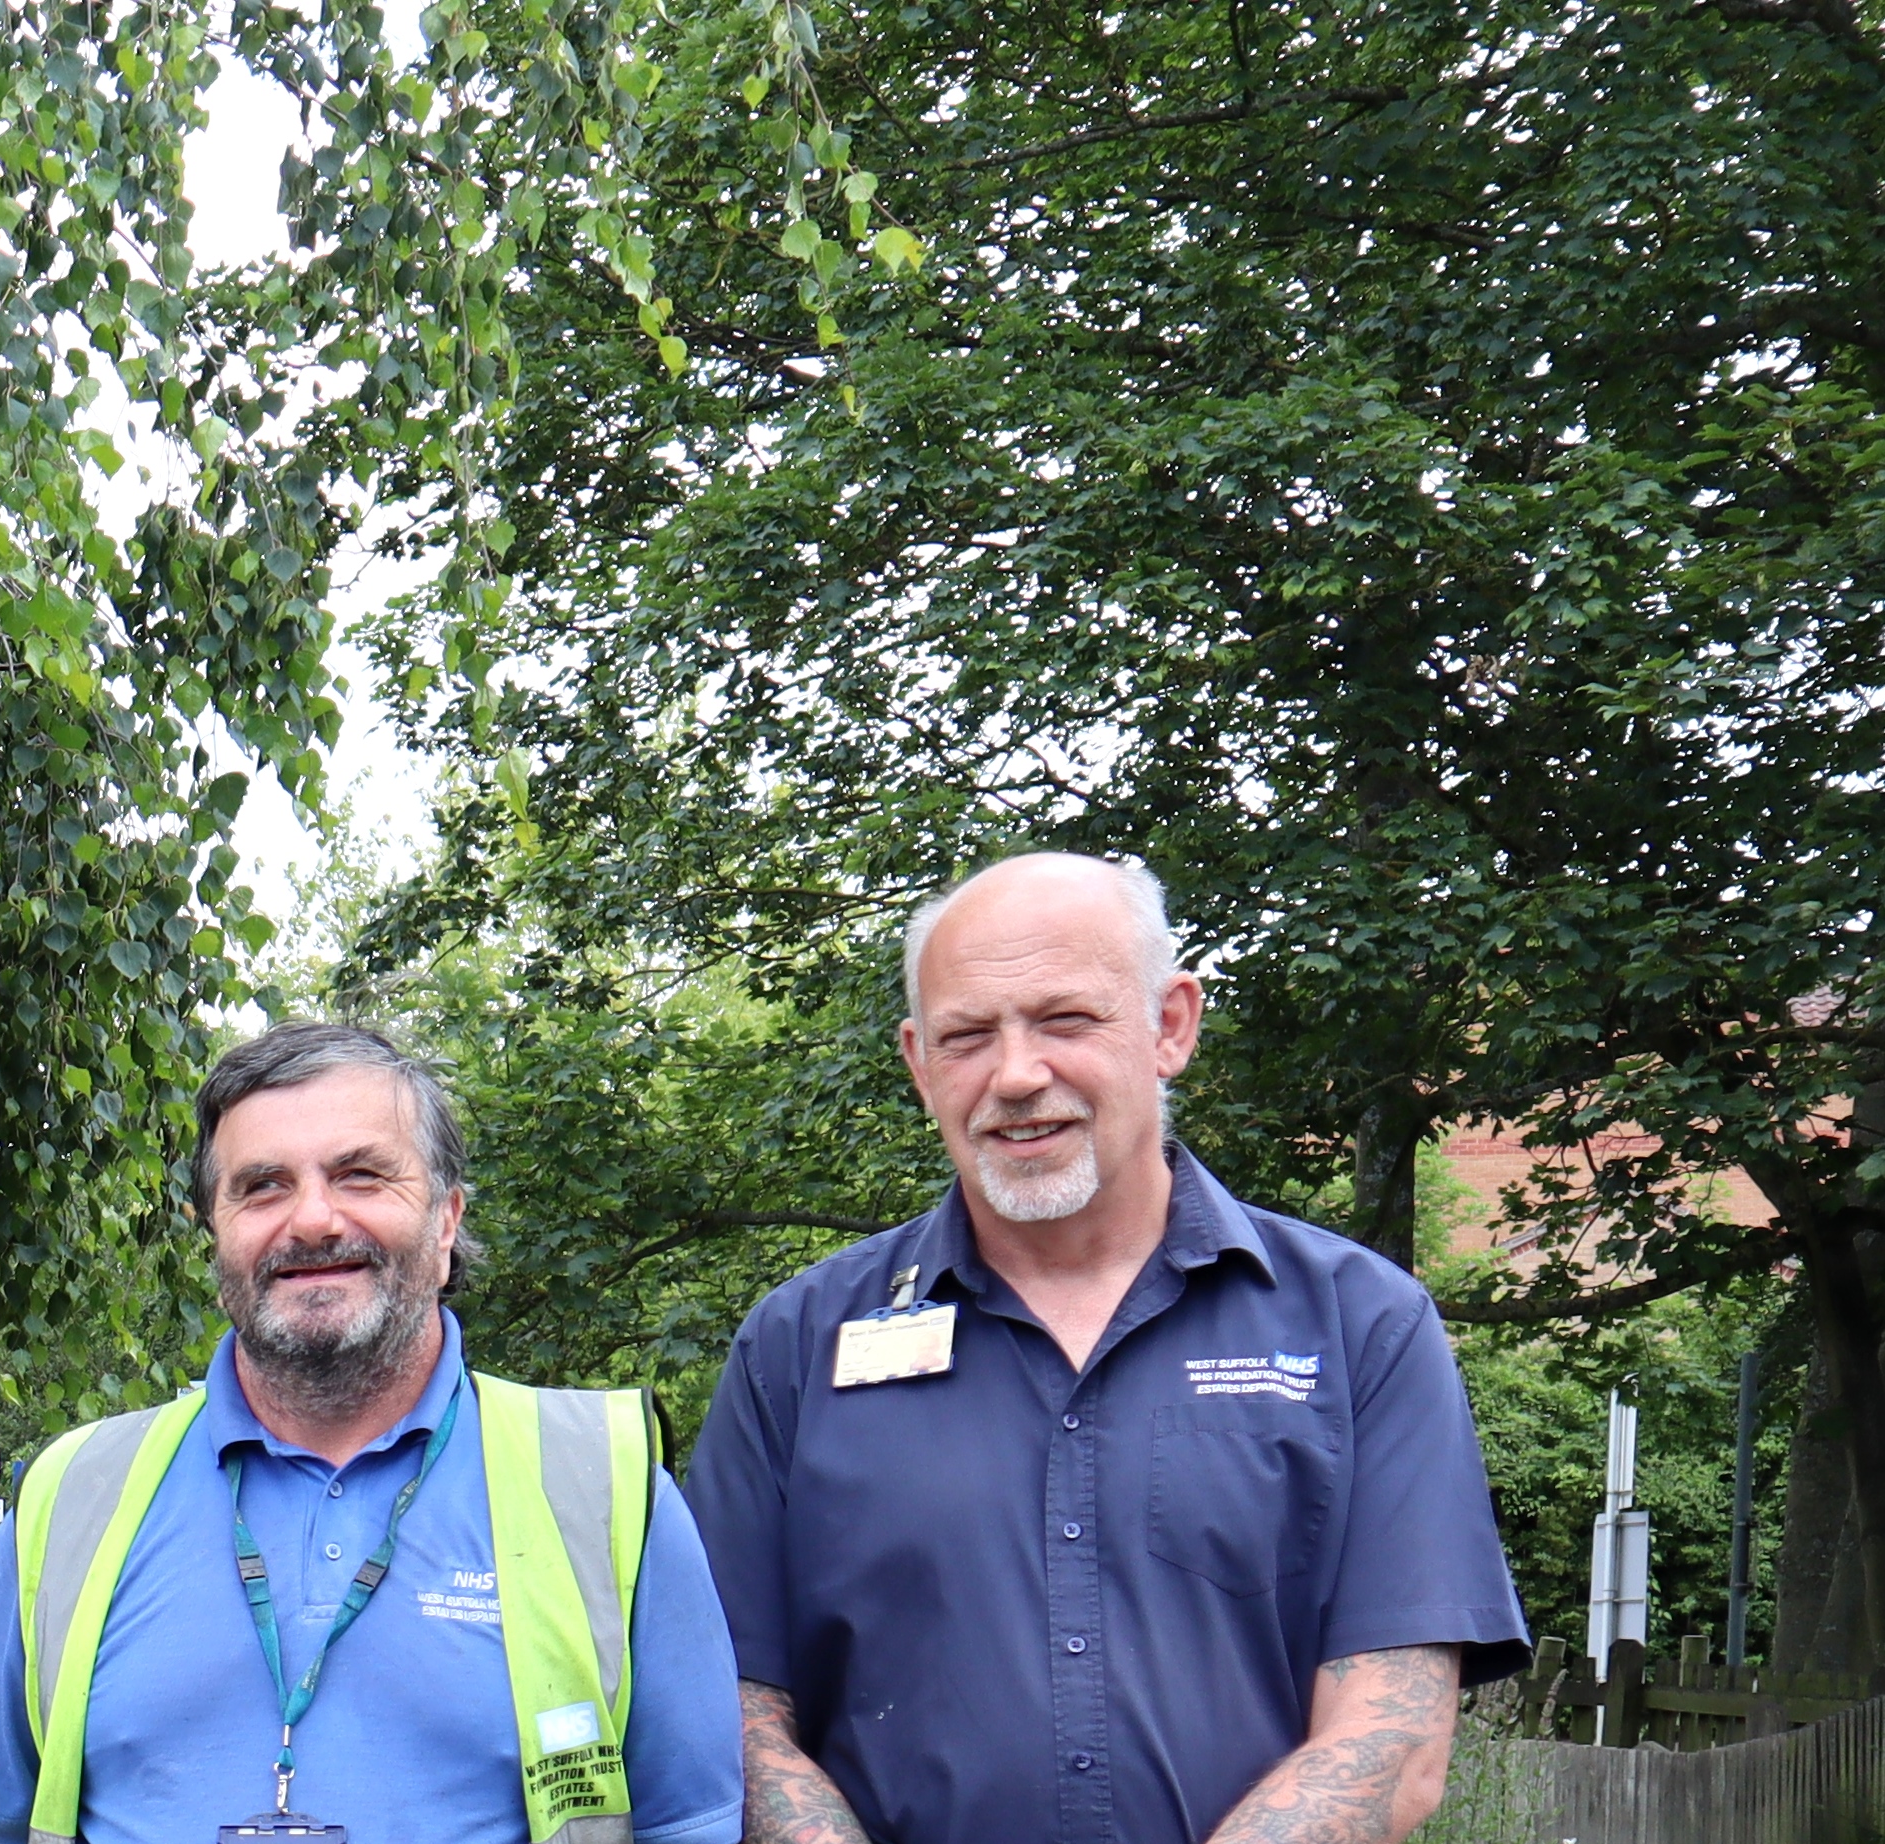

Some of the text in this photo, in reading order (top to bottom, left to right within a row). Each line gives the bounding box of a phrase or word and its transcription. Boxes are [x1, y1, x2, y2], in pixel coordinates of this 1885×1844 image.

[1186, 1354, 1318, 1375] WEST SUFFOLK NHS
[1190, 1370, 1317, 1389] NHS FOUNDATION TRUST
[1197, 1382, 1309, 1401] ESTATES DEPARTMENT
[453, 1570, 496, 1590] NHS
[417, 1591, 444, 1604] WEST
[525, 1757, 549, 1778] WST
[597, 1745, 622, 1757] NHS
[550, 1781, 595, 1801] ESTATES
